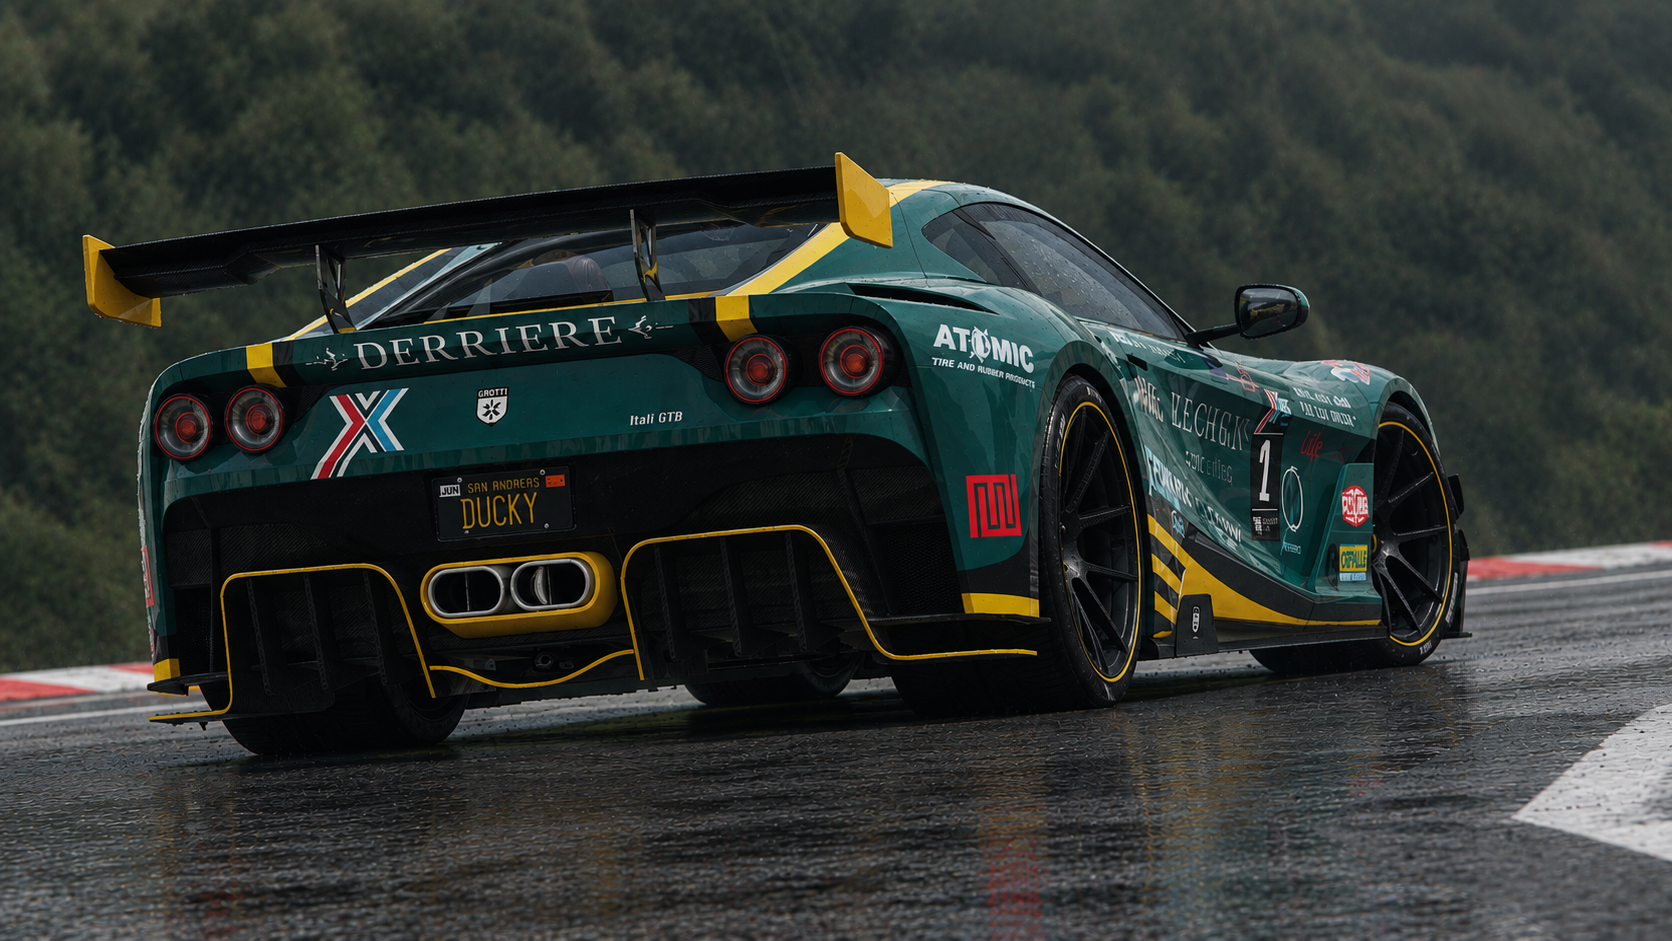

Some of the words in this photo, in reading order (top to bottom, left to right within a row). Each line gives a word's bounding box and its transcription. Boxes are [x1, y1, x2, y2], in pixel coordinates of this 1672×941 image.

[353, 316, 622, 370] DERRIERE
[933, 323, 1035, 374] ATOMIC
[932, 357, 955, 368] TIRE
[957, 361, 975, 372] AND
[977, 366, 1004, 379] RUBBER
[477, 388, 508, 398] GROTTI
[629, 414, 655, 427] Itali
[658, 411, 683, 424] GTB
[1259, 439, 1271, 502] 1
[441, 486, 459, 496] JUN
[467, 482, 488, 494] SAN
[493, 477, 540, 491] ANDREAS
[460, 491, 538, 530] DUCKY
